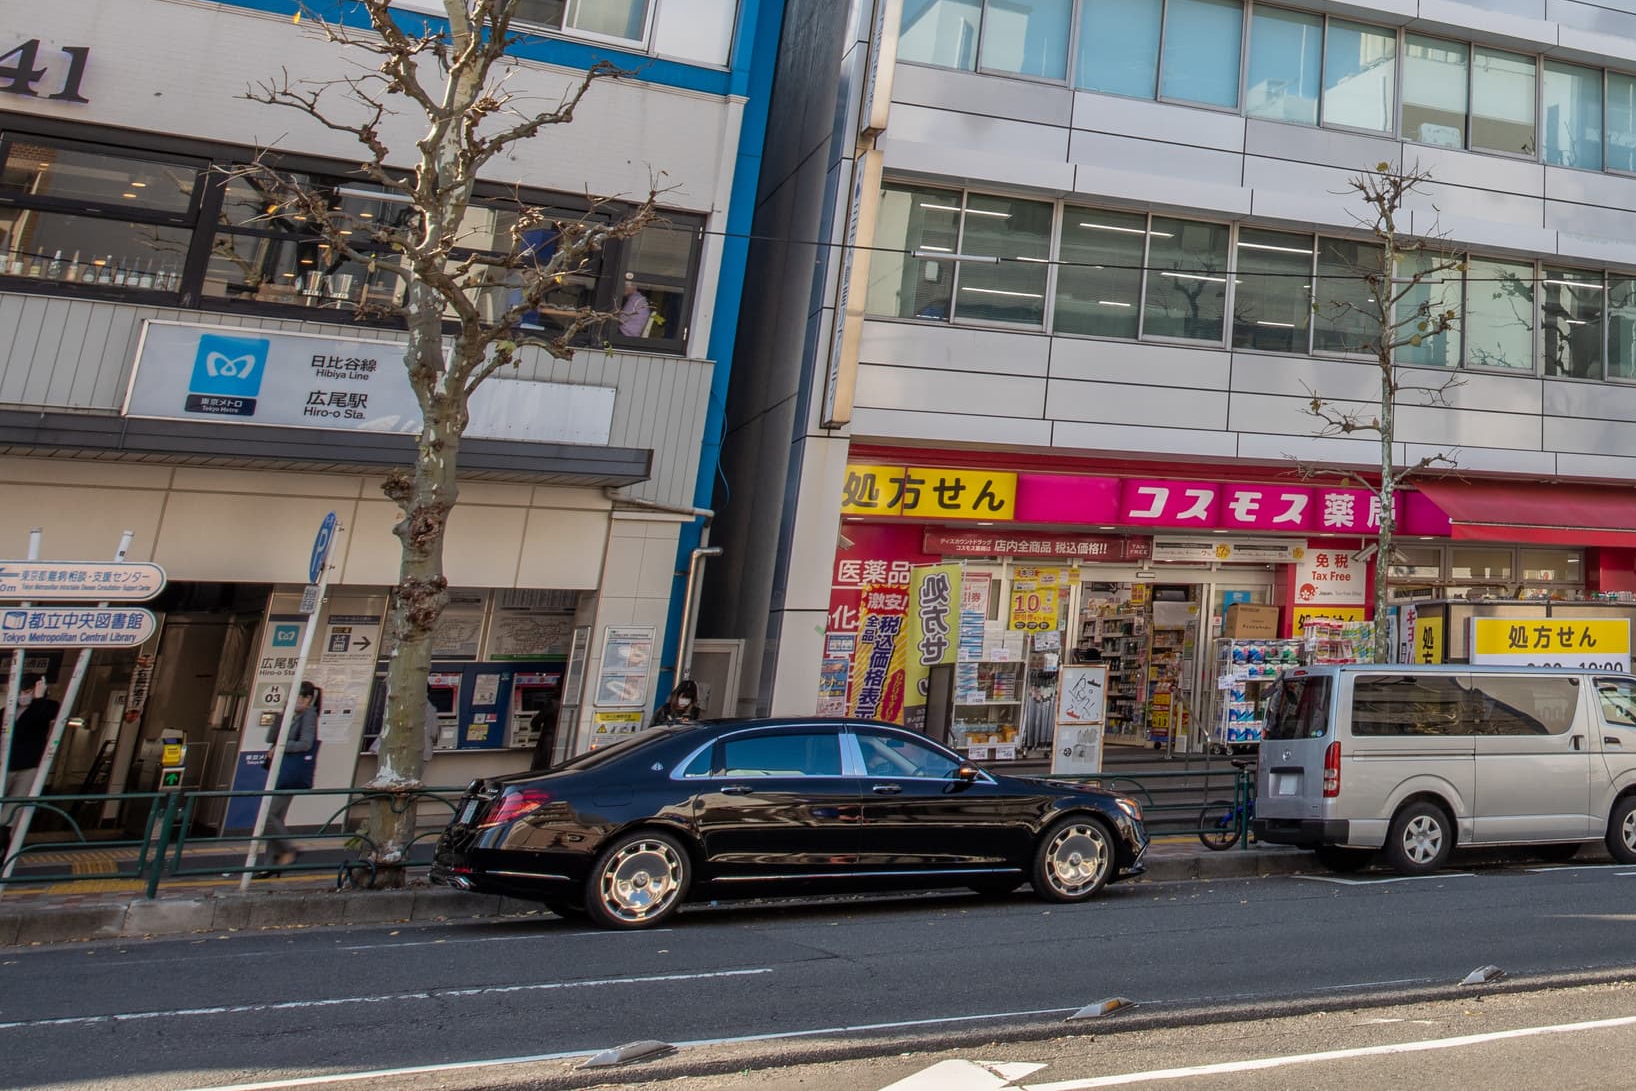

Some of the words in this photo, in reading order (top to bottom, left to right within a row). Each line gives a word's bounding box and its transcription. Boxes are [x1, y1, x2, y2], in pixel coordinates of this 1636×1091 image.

[311, 355, 377, 372] 日比谷線
[316, 369, 346, 380] Hibiya
[350, 372, 369, 381] Line
[201, 397, 243, 408] 東京メトロ
[306, 390, 368, 409] 広尾駅
[304, 406, 340, 420] Hiro-o
[344, 410, 366, 420] Sta.
[842, 471, 1004, 512] 処方せん
[994, 540, 1051, 553] 店内全商品
[1316, 553, 1349, 568] 免税
[21, 570, 150, 583] 東京都難病相談・支援センター
[838, 559, 910, 586] 医薬品
[1312, 571, 1328, 581] Tax
[1330, 571, 1351, 581] Free
[866, 592, 909, 611] 激安!
[28, 612, 145, 630] 都立中央図書館
[861, 615, 878, 643] 全品
[2, 632, 26, 644] Tokyo
[28, 632, 77, 643] Metropolitan
[79, 632, 108, 642] Central
[110, 633, 137, 643] Library
[1508, 625, 1597, 650] 処方せん
[260, 669, 282, 677] Hiro-o
[265, 694, 281, 703] 03
